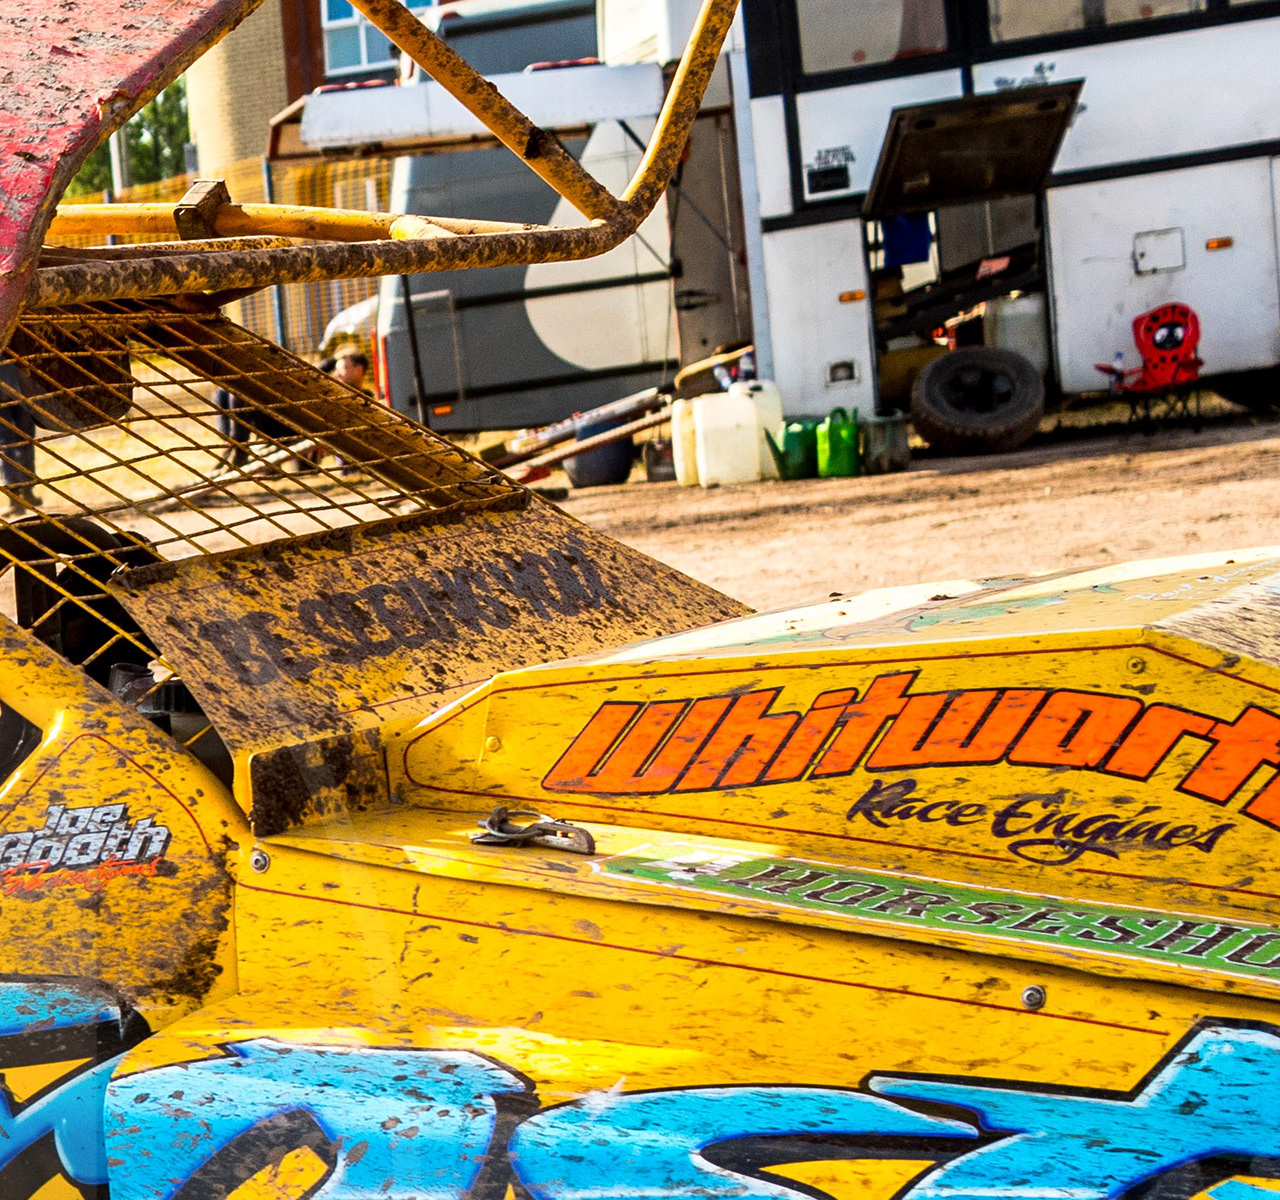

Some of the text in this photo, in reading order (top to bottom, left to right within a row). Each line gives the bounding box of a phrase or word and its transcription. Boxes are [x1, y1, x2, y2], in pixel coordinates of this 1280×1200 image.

[34, 802, 128, 838] Joe
[847, 777, 1237, 866] Race Engines
